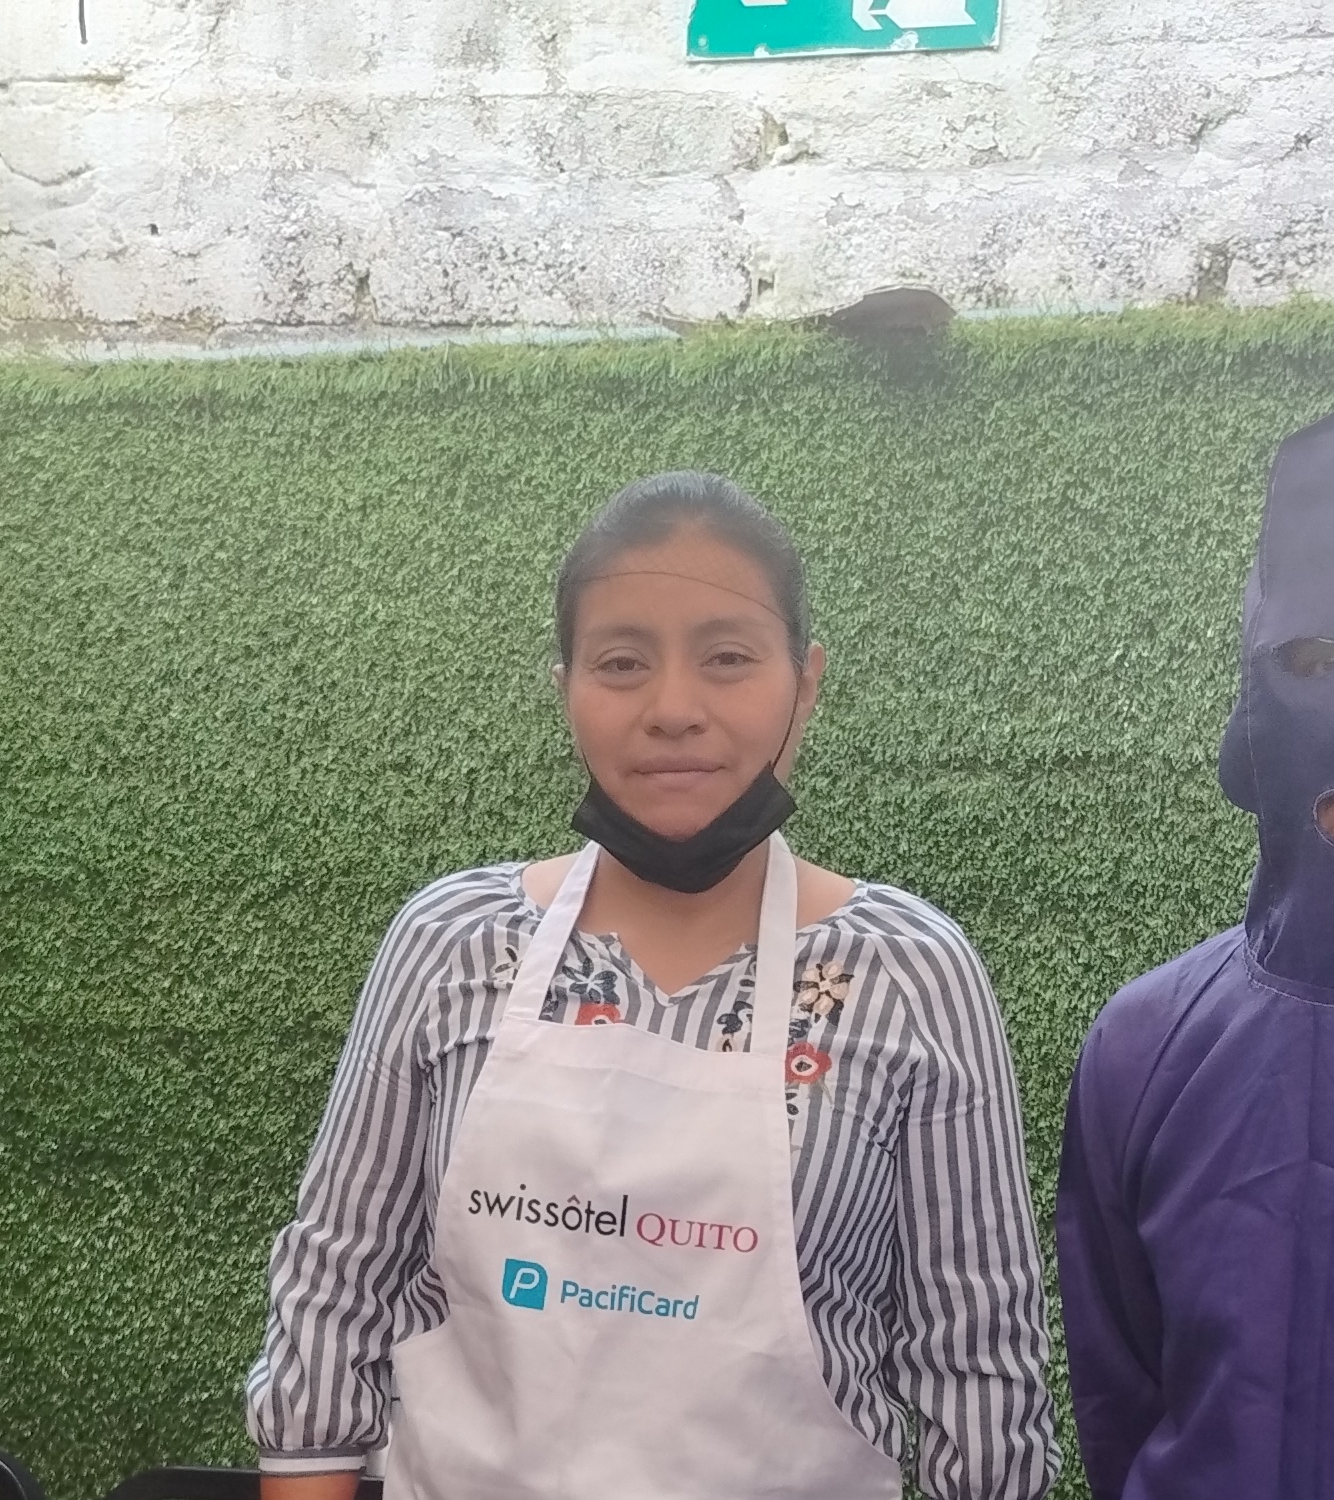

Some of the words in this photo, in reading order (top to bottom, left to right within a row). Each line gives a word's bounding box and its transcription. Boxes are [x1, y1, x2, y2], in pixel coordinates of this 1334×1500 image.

[468, 1184, 629, 1237] swissôtel
[636, 1213, 759, 1253] QUITO
[560, 1279, 700, 1320] PacifiCard
